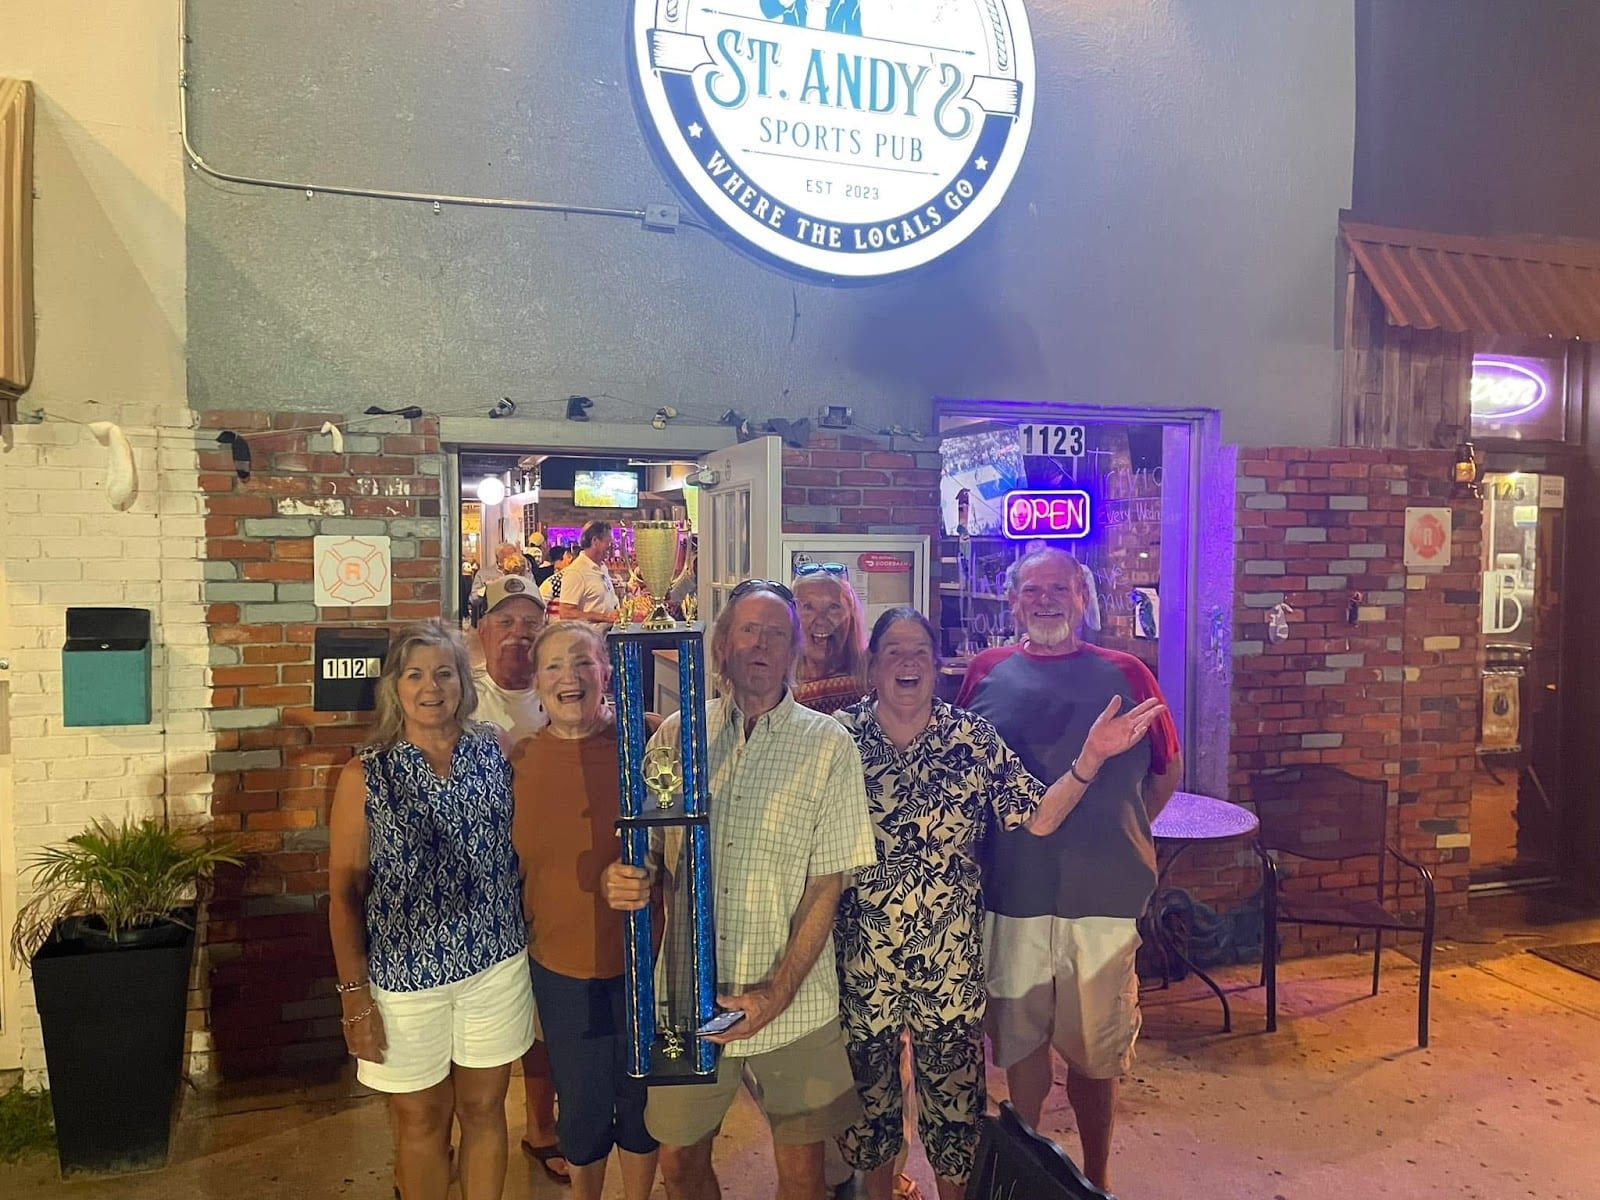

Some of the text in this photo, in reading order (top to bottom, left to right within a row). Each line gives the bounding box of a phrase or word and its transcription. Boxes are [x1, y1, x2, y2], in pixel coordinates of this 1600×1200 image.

[705, 29, 974, 139] ST. ANDY'S
[759, 117, 923, 163] SPORTS PUB
[705, 150, 975, 249] WHERE THE LOCALS GO
[806, 180, 880, 201] EST 2023
[1023, 425, 1083, 456] 1123
[1010, 498, 1084, 530] OPEN
[345, 562, 361, 580] R
